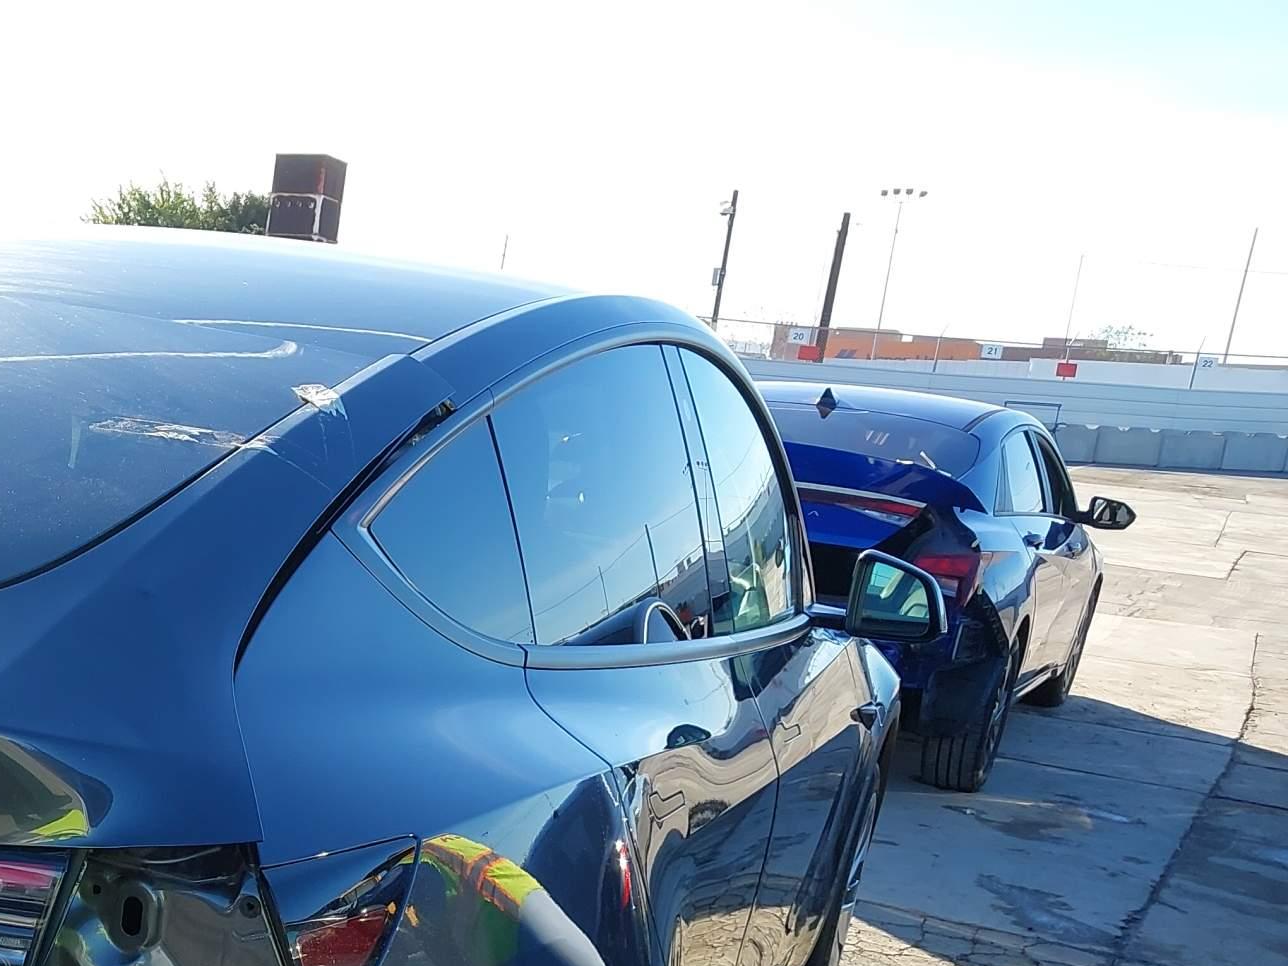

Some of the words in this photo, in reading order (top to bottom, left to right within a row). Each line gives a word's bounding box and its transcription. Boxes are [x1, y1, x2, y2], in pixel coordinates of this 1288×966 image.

[792, 332, 805, 341] 20
[986, 346, 998, 355] 21
[1201, 359, 1214, 368] 22
